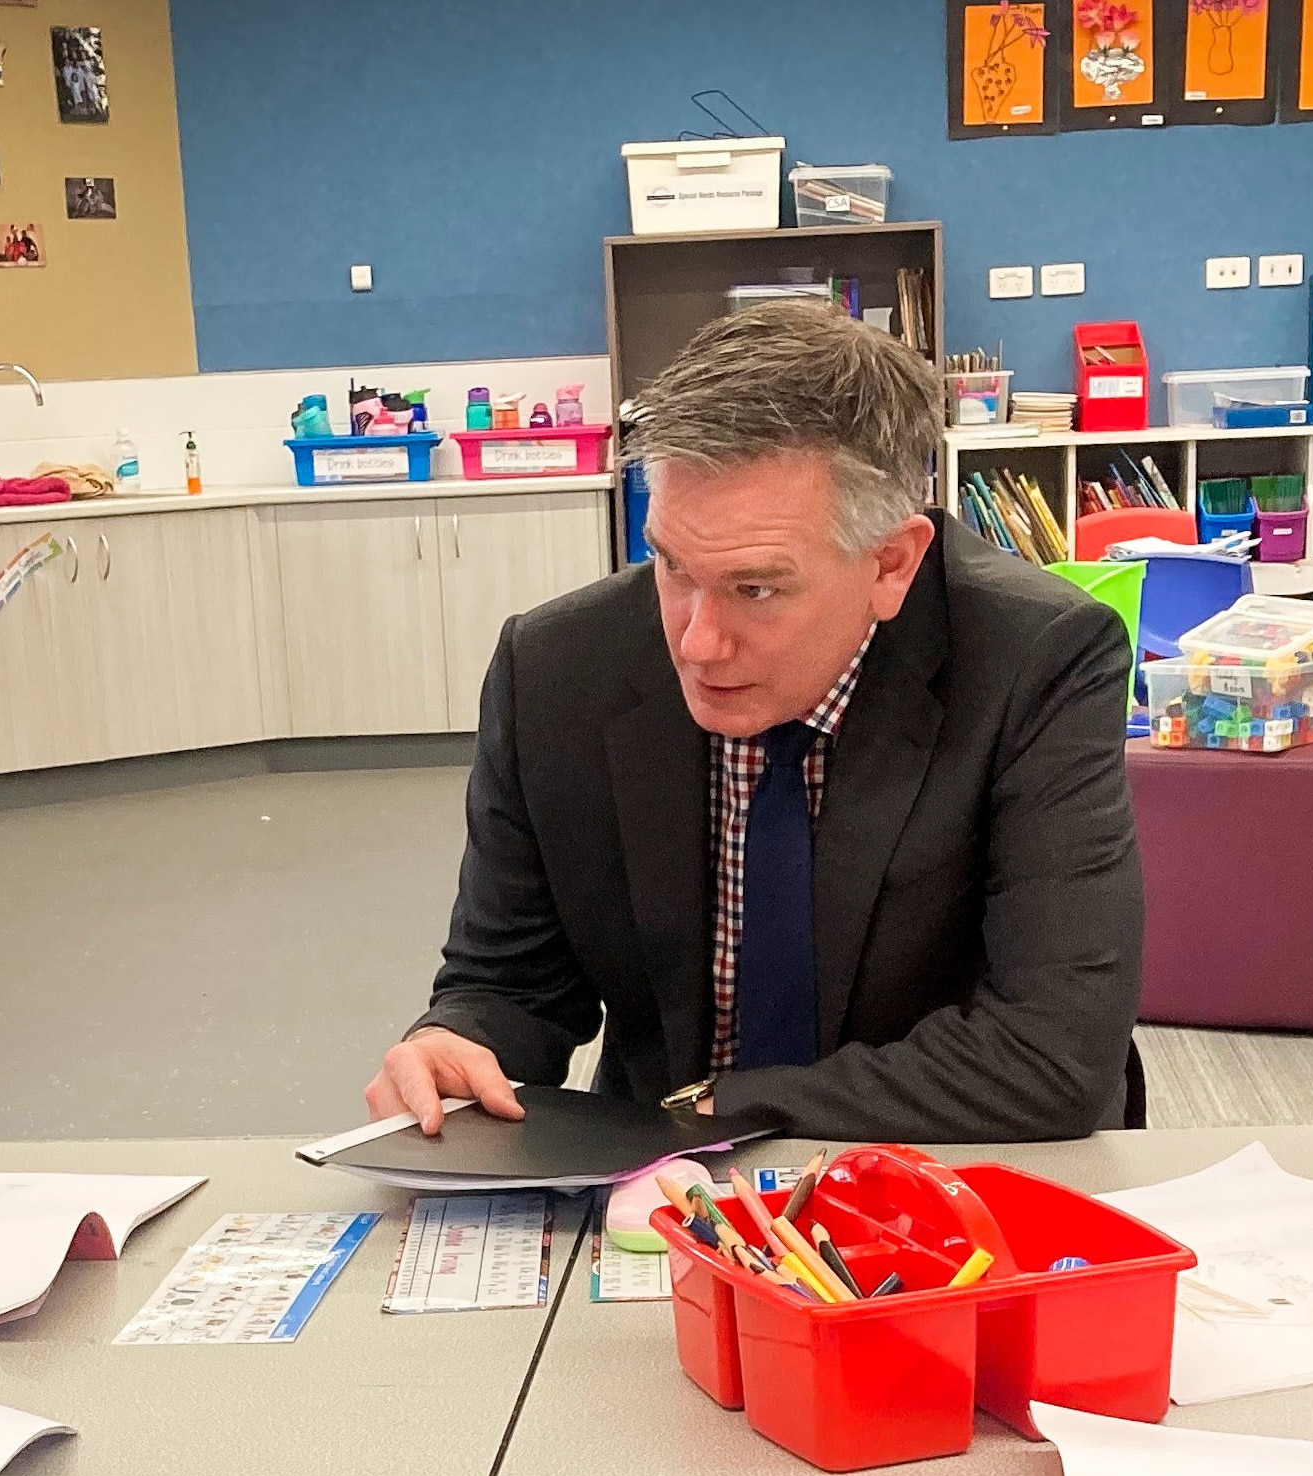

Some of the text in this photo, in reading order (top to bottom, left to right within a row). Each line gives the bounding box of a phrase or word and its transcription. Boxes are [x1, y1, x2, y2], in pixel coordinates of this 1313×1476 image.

[495, 447, 563, 461] Drink bottles
[327, 457, 395, 471] Drink bottles
